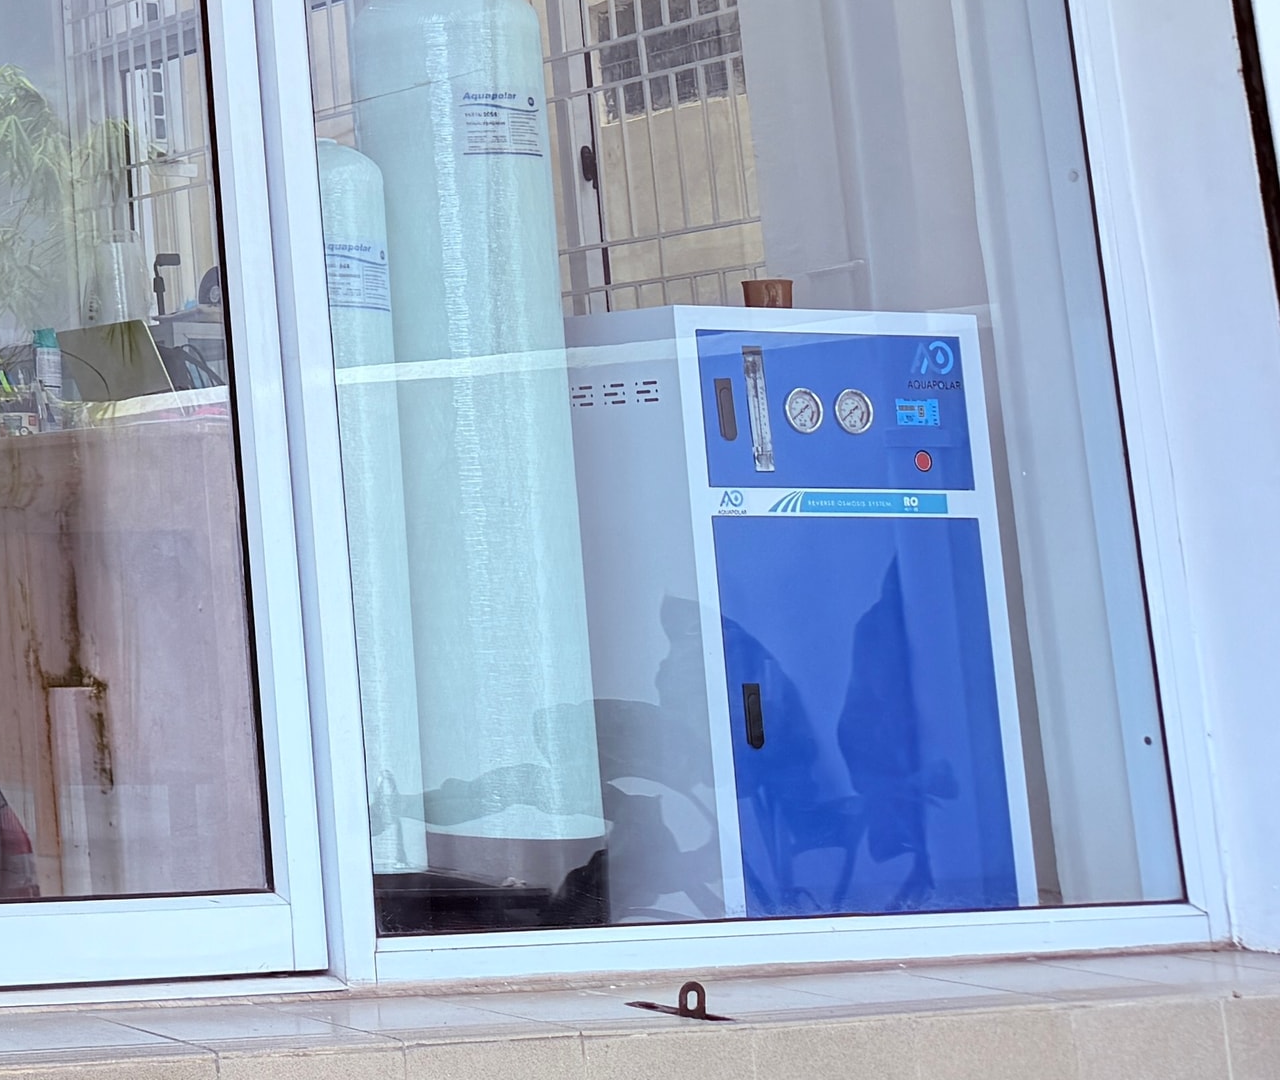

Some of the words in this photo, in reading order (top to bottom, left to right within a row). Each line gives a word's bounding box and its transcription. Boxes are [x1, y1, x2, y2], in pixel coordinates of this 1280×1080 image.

[327, 243, 372, 252] quapolar
[907, 379, 962, 391] AQUAPOLAR
[903, 496, 919, 507] RO
